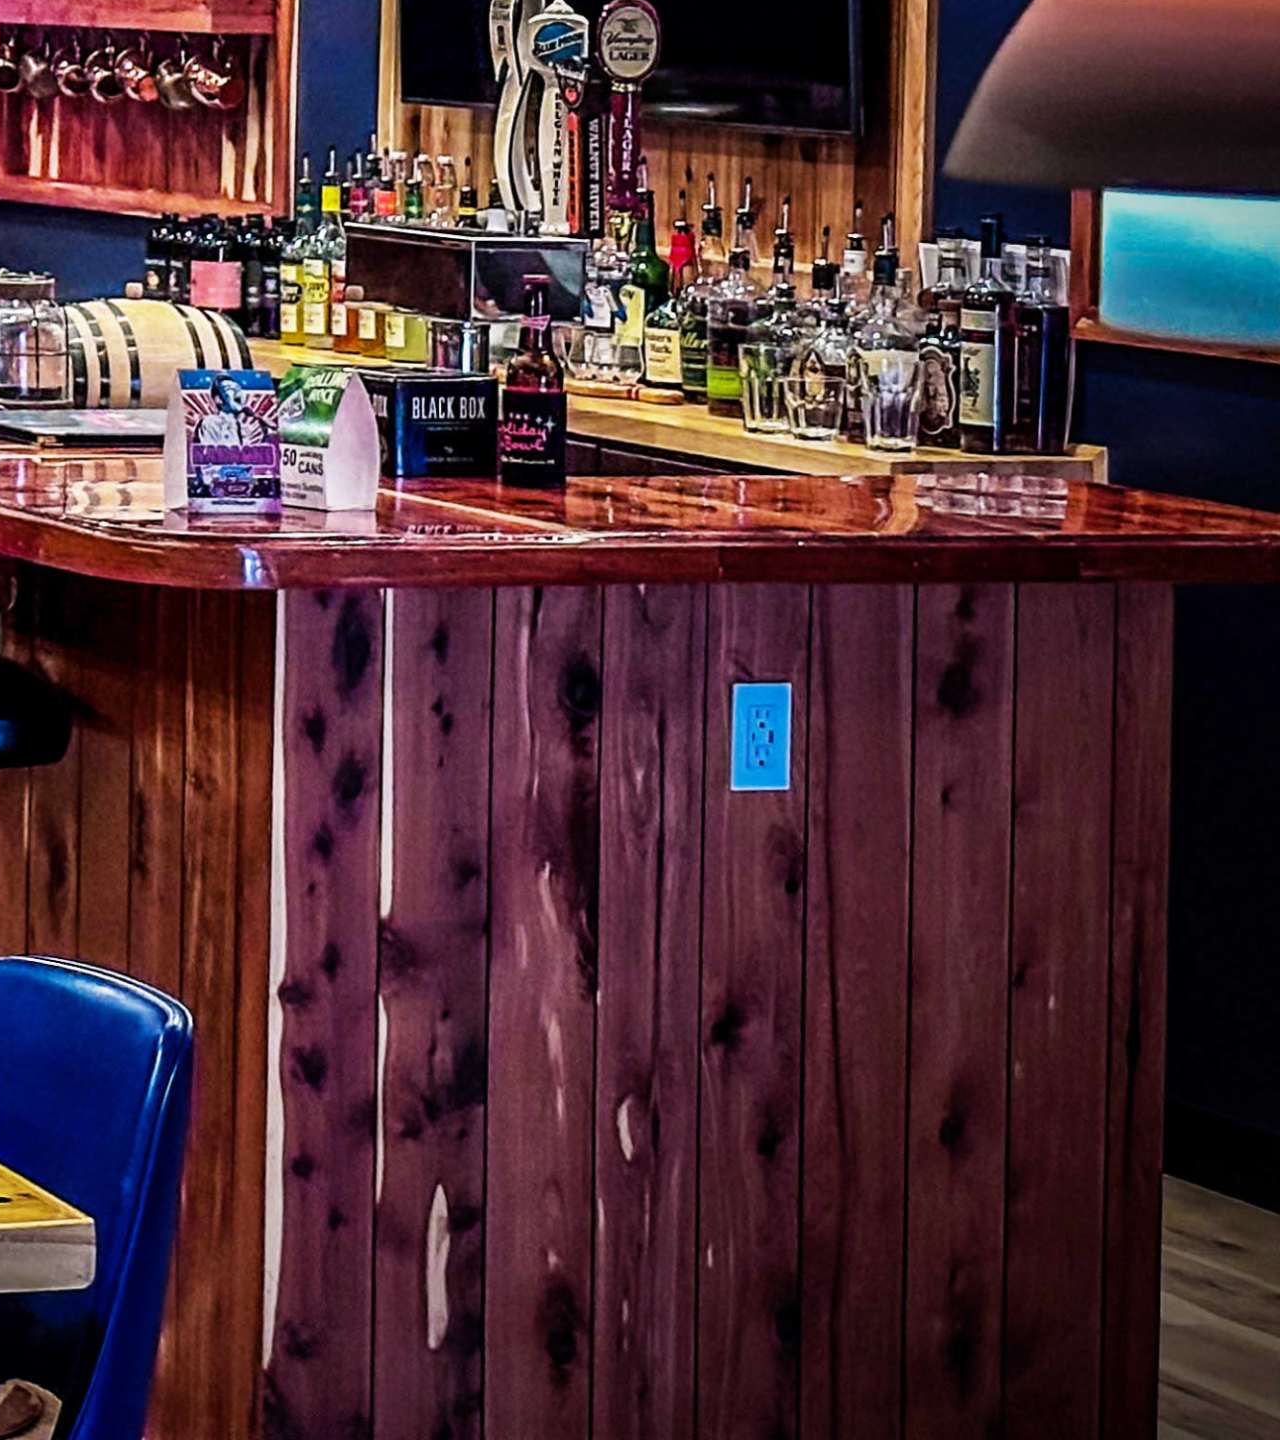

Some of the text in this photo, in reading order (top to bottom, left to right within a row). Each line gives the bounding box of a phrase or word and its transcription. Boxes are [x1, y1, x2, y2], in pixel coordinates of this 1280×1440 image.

[588, 118, 601, 231] WALNUT RIVER
[411, 396, 486, 420] BLACK BOX
[297, 460, 324, 476] CANS
